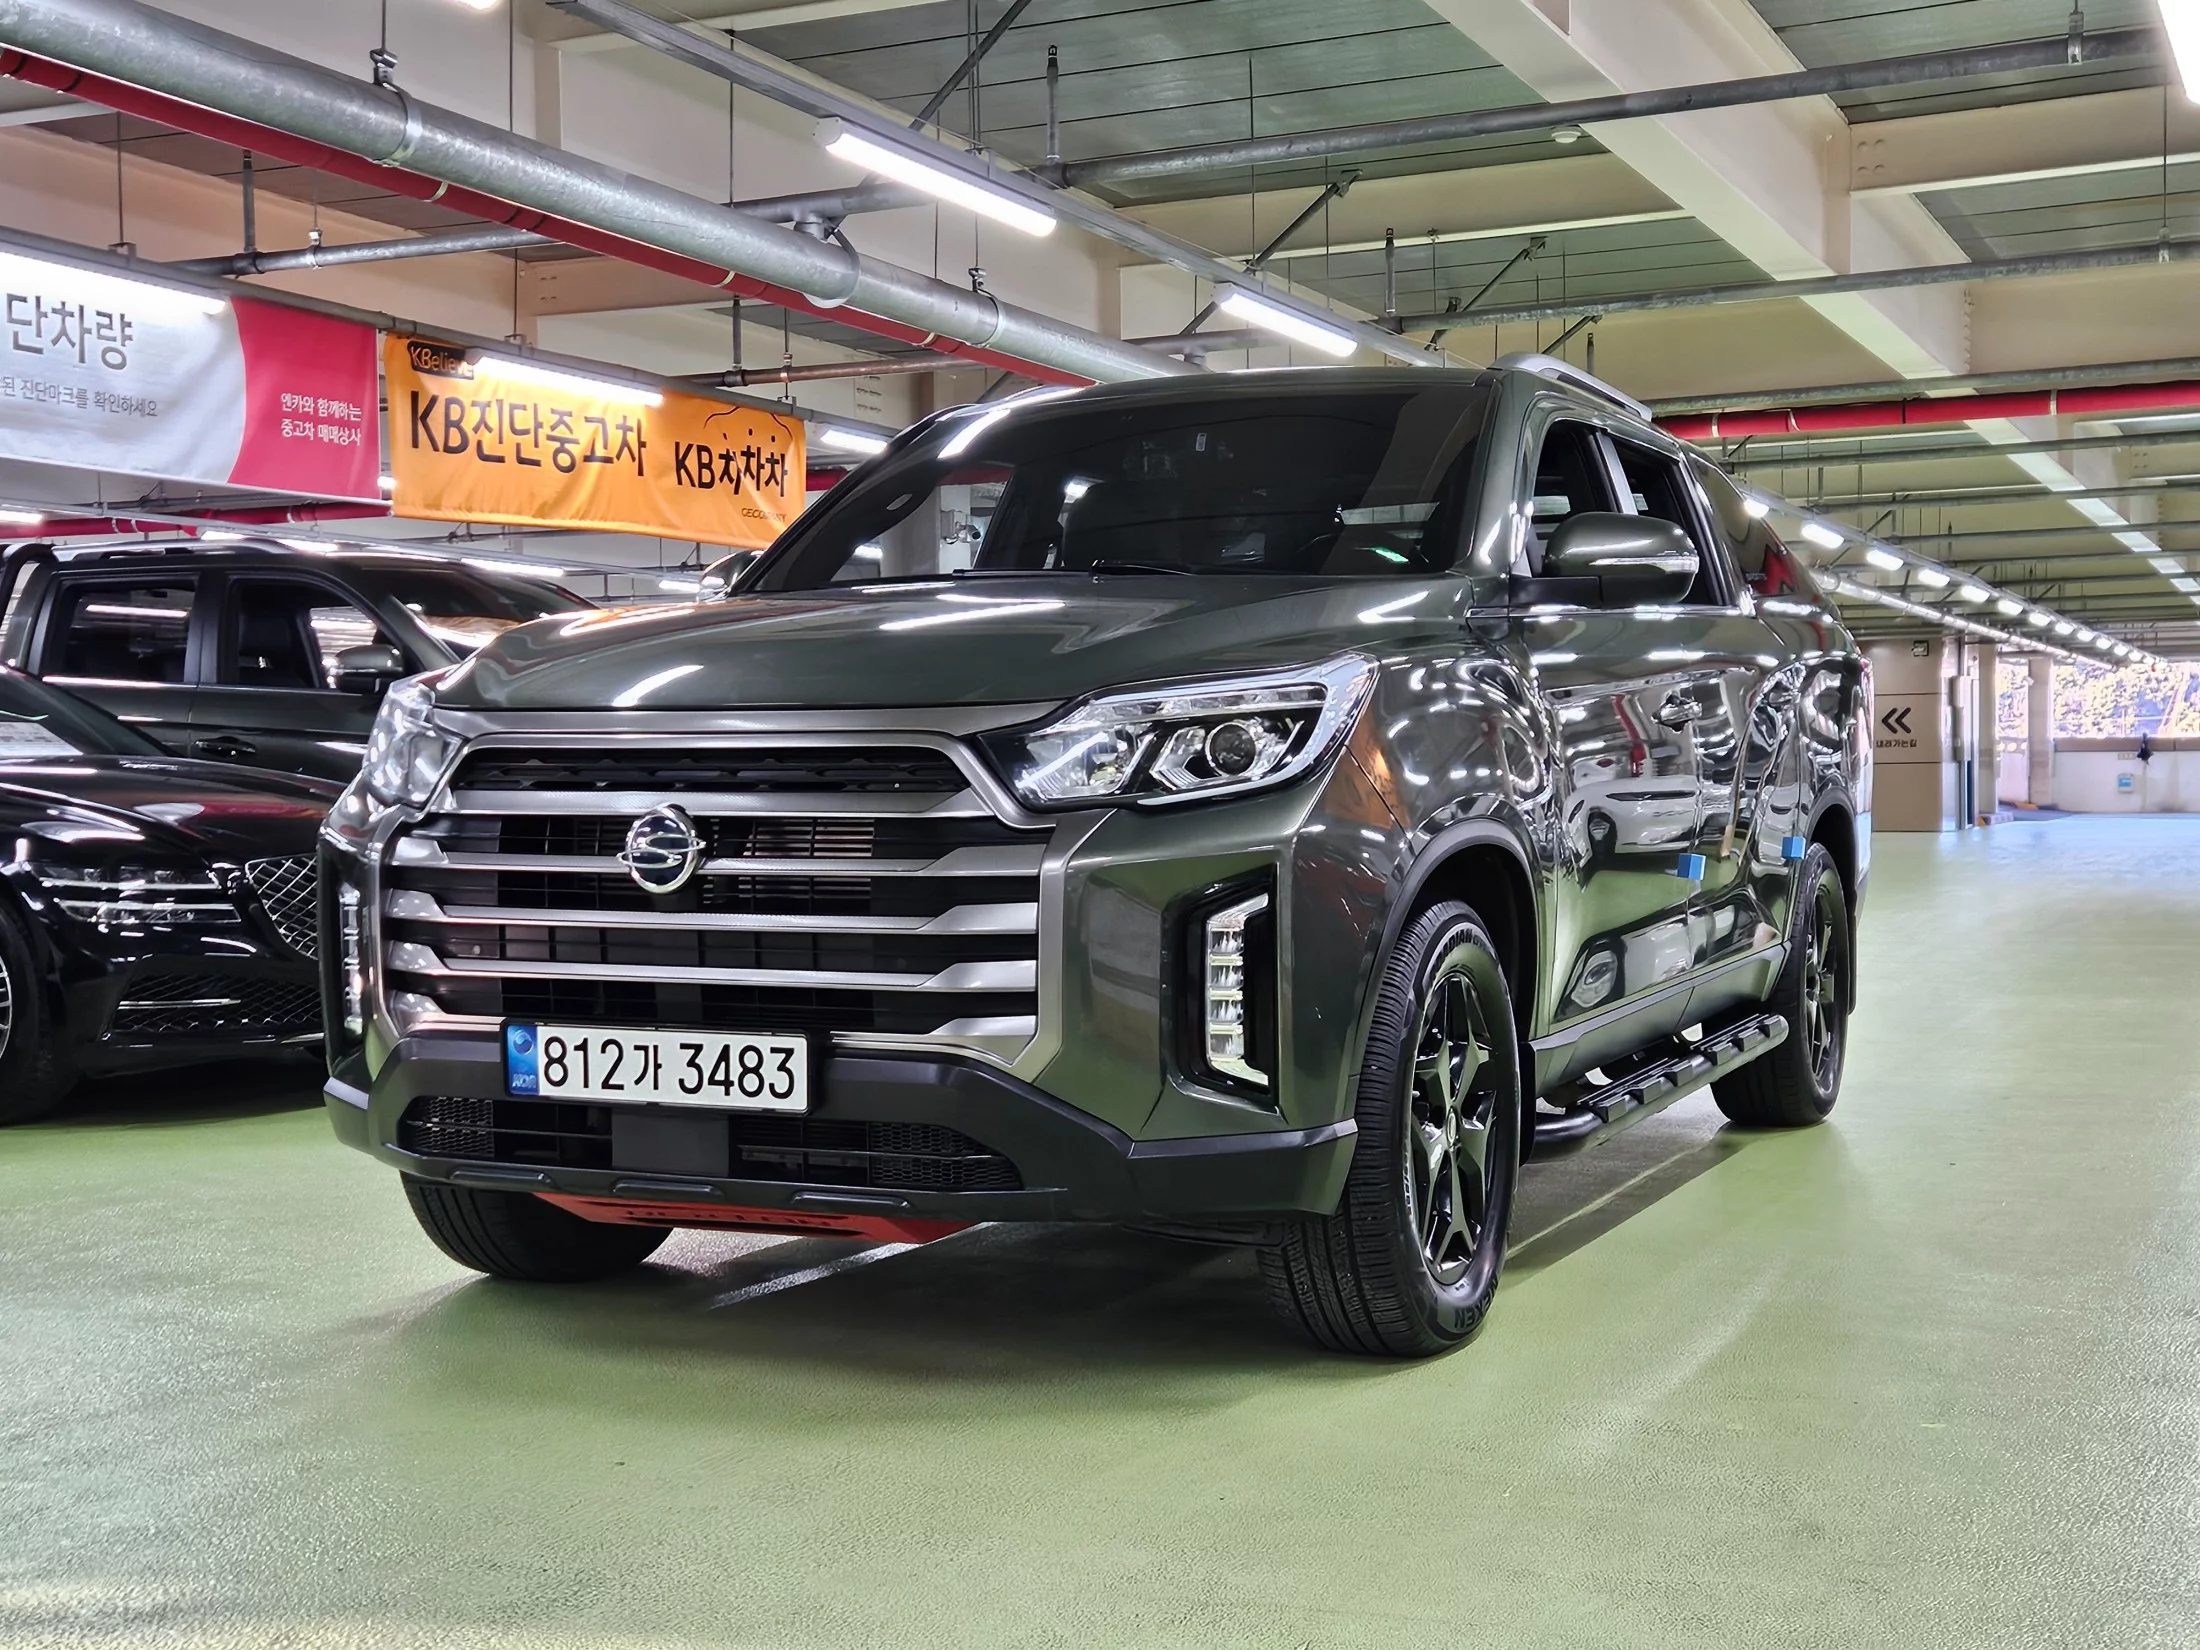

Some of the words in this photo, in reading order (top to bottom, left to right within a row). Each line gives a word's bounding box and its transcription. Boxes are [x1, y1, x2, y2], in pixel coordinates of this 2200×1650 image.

[5, 292, 134, 371] 단차량
[0, 376, 16, 397] 된
[20, 379, 89, 409] 진단마크를
[93, 390, 158, 418] 확인하세요
[281, 392, 315, 415] 엔카와
[316, 397, 362, 421] 함께하는
[280, 418, 315, 441] 중고차
[317, 424, 361, 446] 매매상사
[410, 390, 647, 477] KB진단중고차
[674, 428, 789, 498] KB차차차
[543, 1036, 662, 1090] 812가
[678, 1042, 795, 1099] 3483
